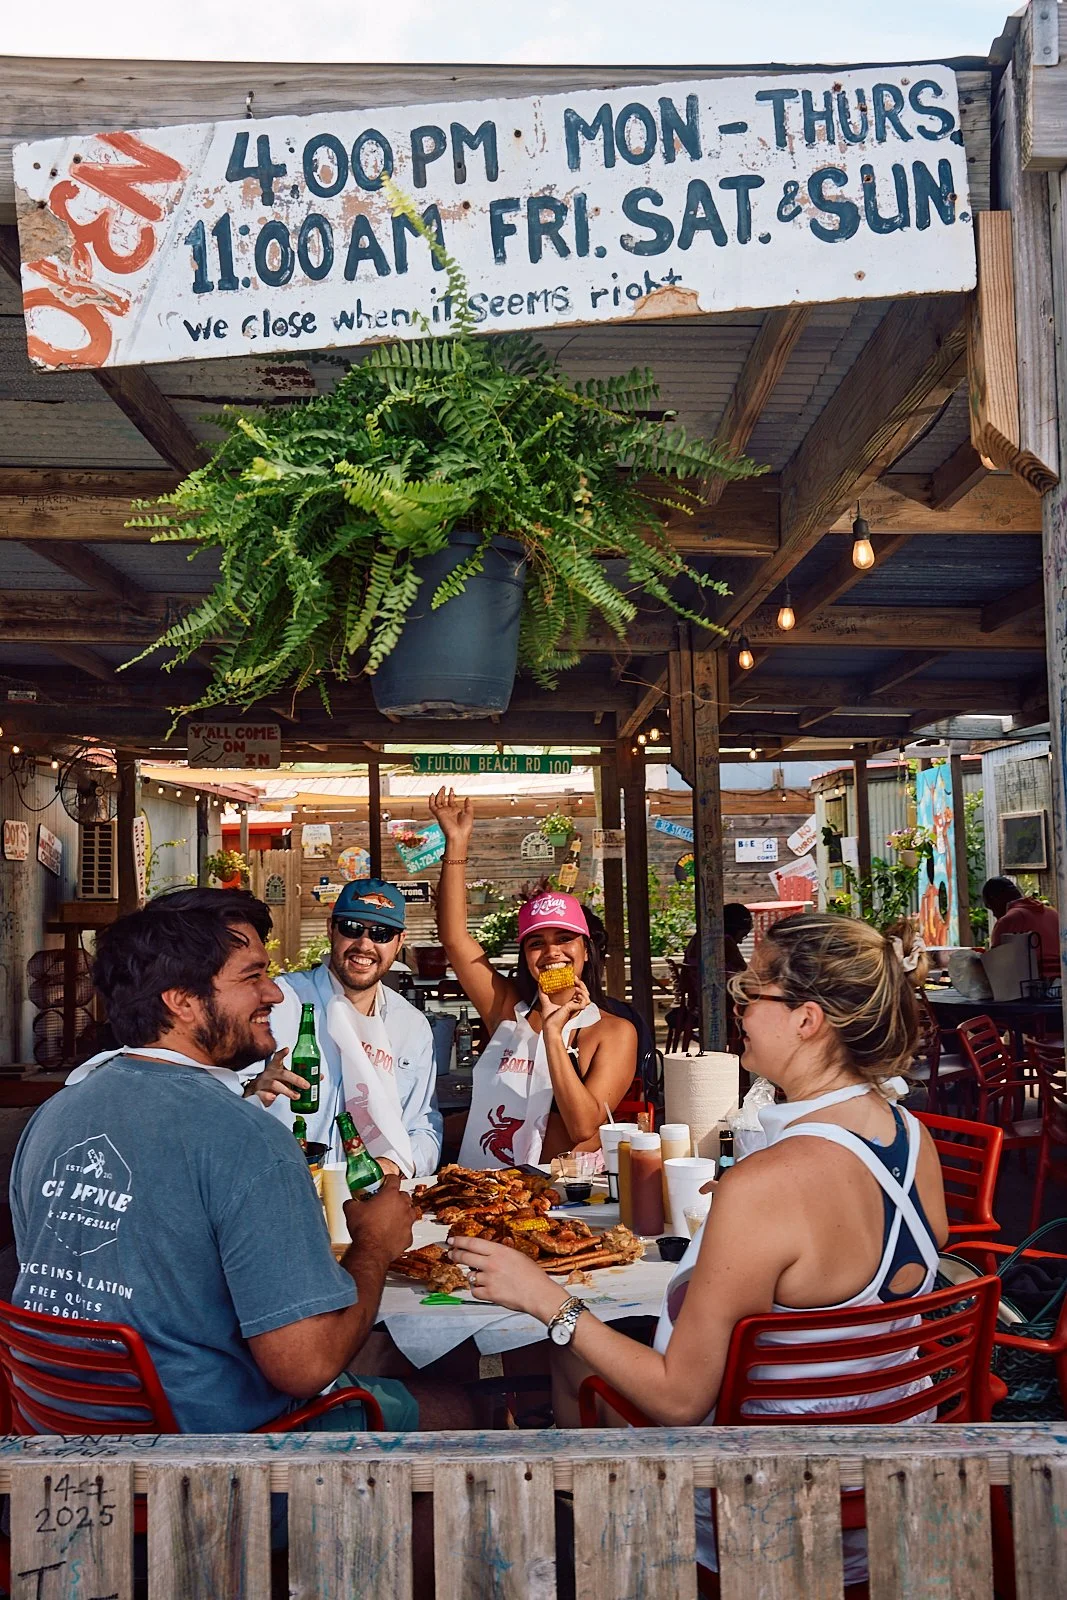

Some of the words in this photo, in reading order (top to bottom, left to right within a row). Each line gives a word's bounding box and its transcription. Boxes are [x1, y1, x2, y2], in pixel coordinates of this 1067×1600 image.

[491, 192, 607, 265] FRI.
[620, 175, 771, 257] SAT.
[183, 316, 229, 341] we
[242, 308, 317, 340] close
[331, 299, 412, 332] when
[468, 286, 571, 323] seems
[190, 725, 231, 739] Y'ALL
[235, 727, 278, 740] COME
[223, 740, 246, 753] ON
[245, 753, 271, 766] IN
[414, 756, 421, 770] S
[427, 756, 471, 771] FULTON
[478, 756, 518, 772] BEACH
[526, 757, 541, 772] RD
[549, 760, 570, 774] 100
[797, 824, 811, 839] NO
[29, 1284, 57, 1299] FREE
[35, 1504, 117, 1533] 2025
